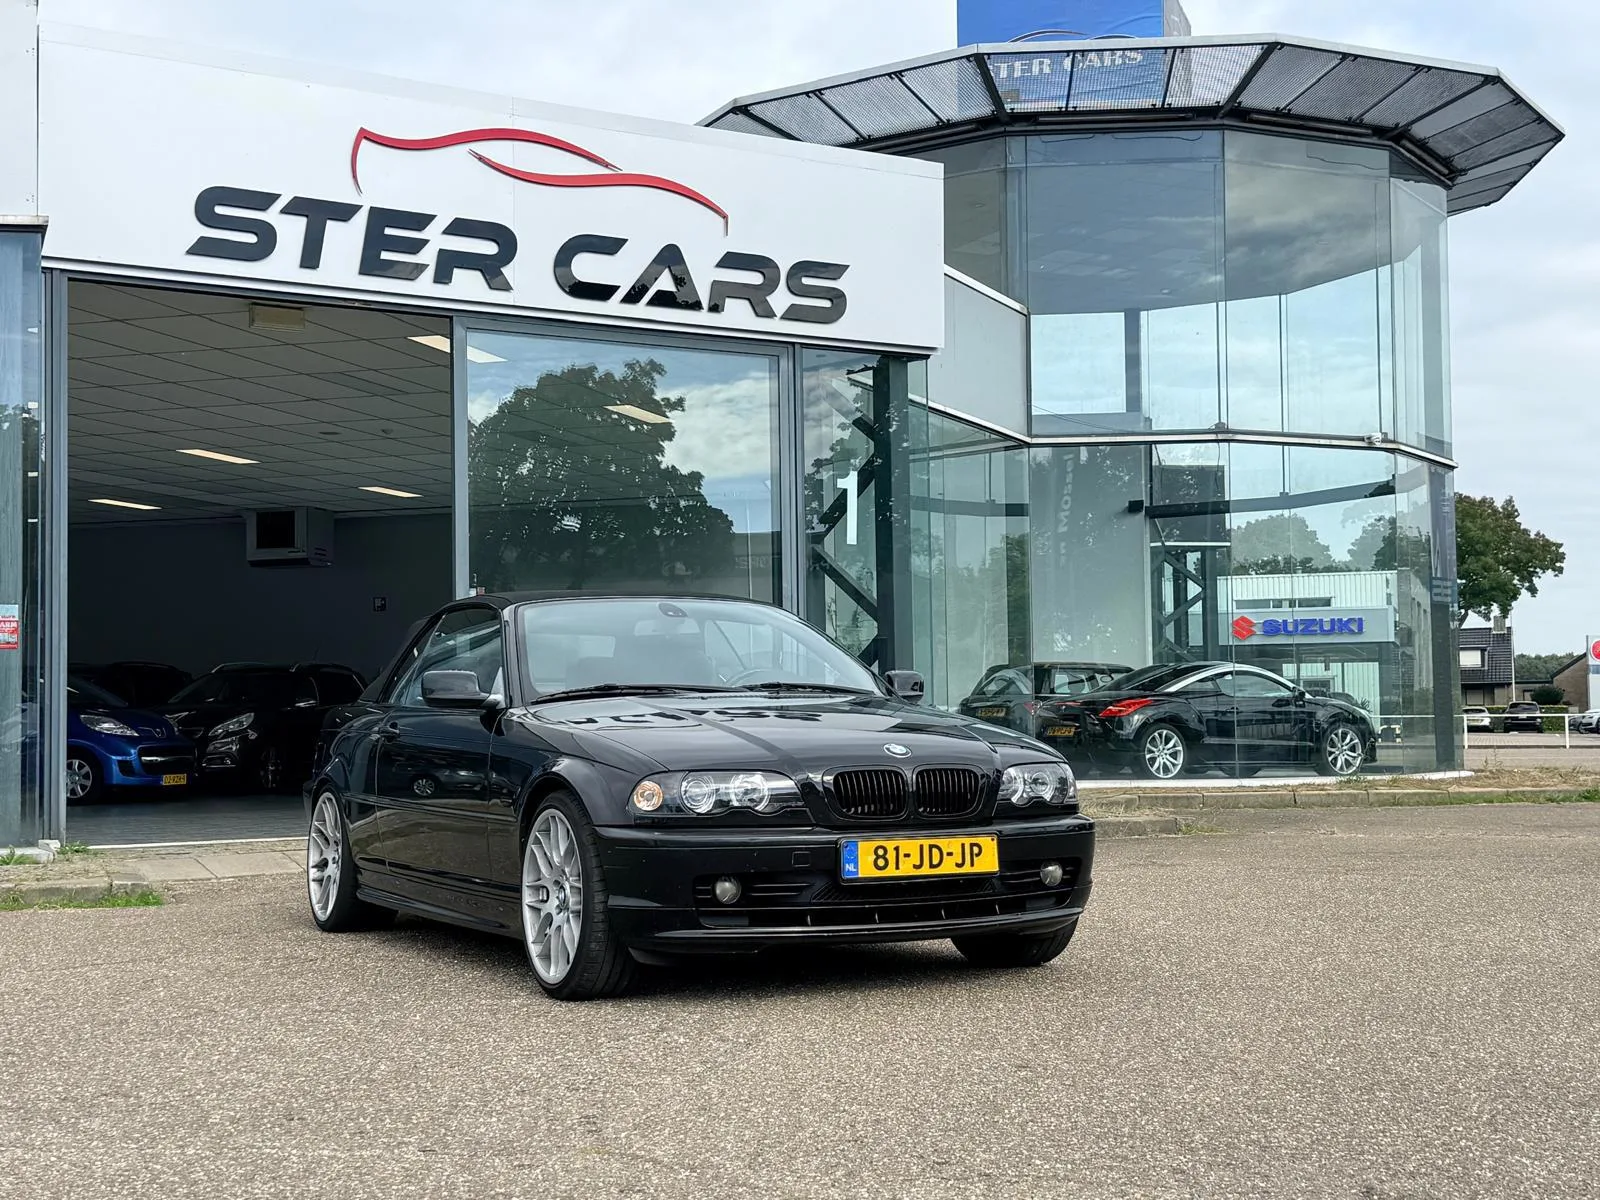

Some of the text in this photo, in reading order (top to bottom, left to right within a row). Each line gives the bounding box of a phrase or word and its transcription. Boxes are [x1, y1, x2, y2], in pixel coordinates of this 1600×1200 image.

[988, 58, 1052, 80] TER
[185, 185, 850, 324] STER CARS
[837, 470, 858, 545] 1
[1262, 617, 1364, 636] SUZUKI
[845, 864, 857, 872] NL
[873, 842, 983, 871] 81-JD-JP
